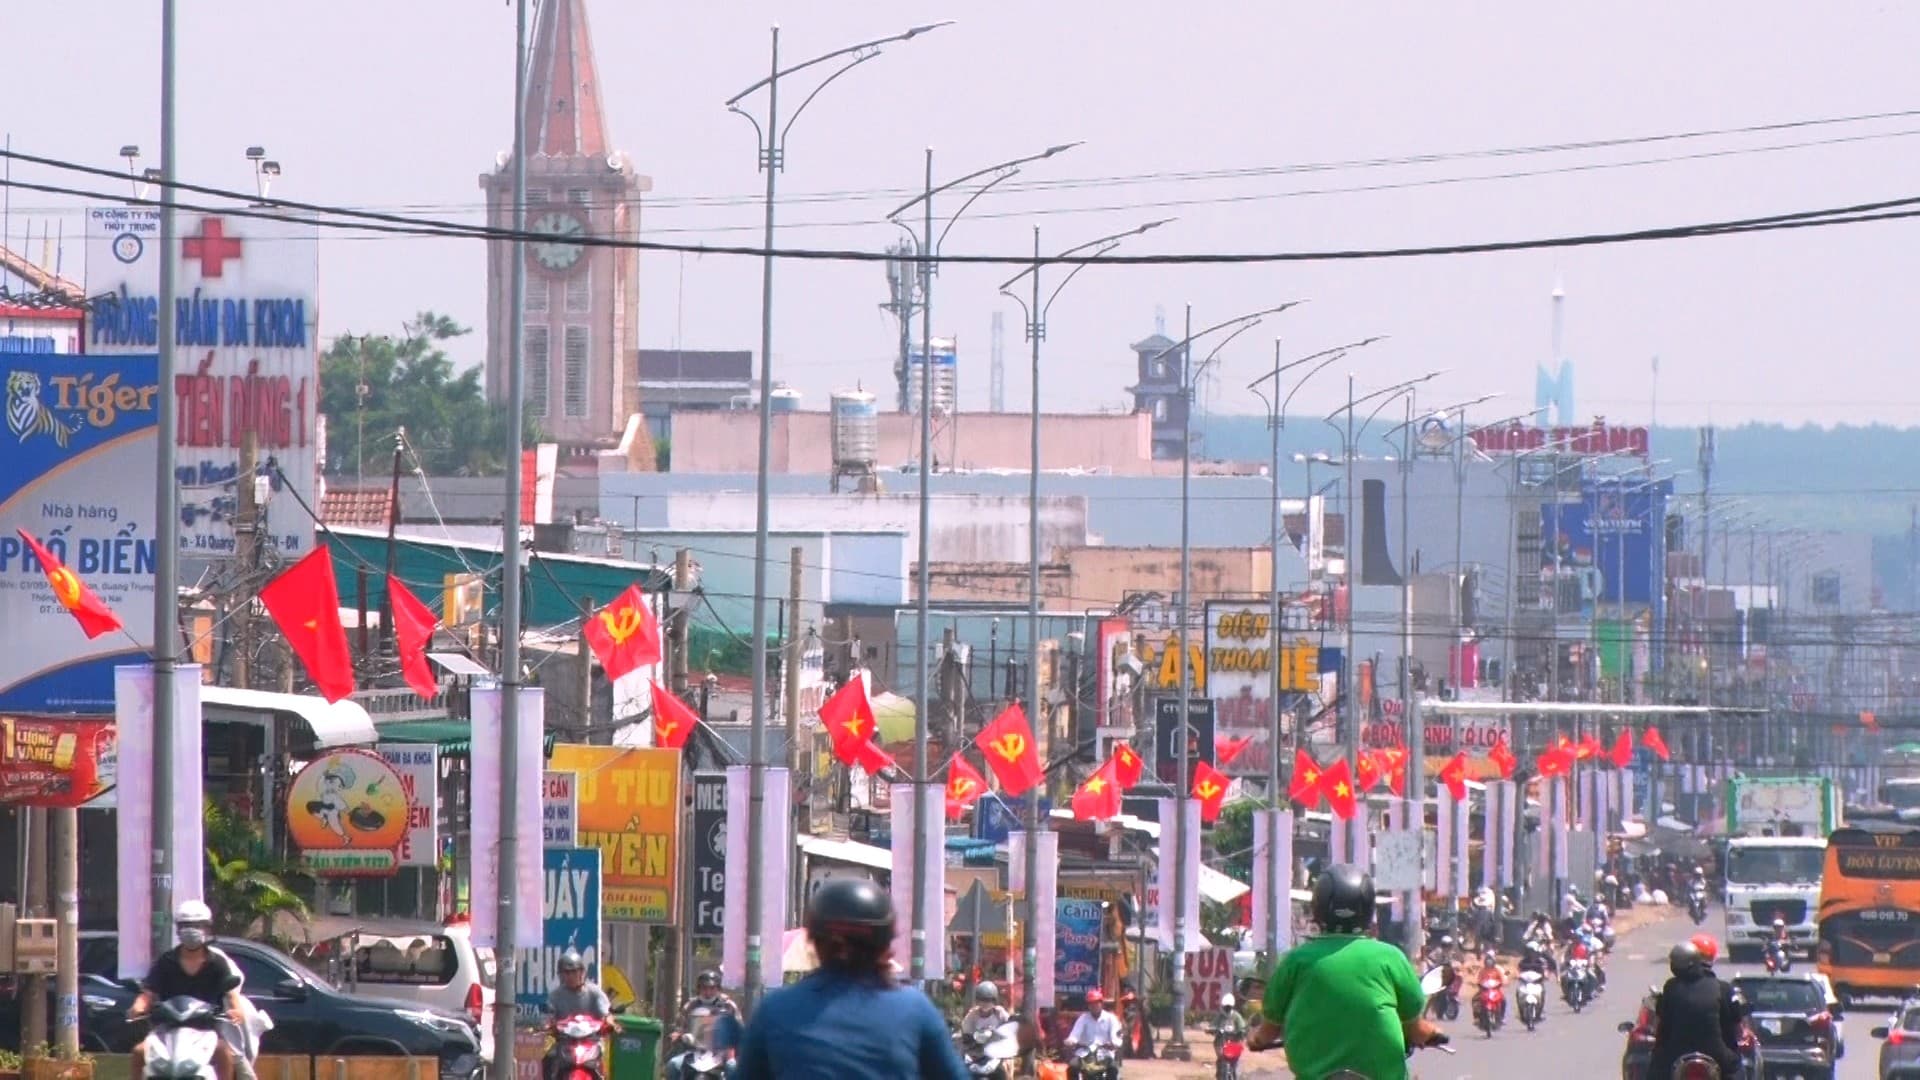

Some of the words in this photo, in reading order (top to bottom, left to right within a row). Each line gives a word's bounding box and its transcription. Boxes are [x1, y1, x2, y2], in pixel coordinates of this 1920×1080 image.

[254, 298, 304, 347] KHOA
[42, 503, 73, 518] Nhà
[78, 503, 117, 522] hàng
[79, 522, 157, 574] BIỂN
[1217, 607, 1269, 642] ĐIỆN
[1210, 648, 1271, 677] THOẠI
[543, 851, 590, 920] UẦY
